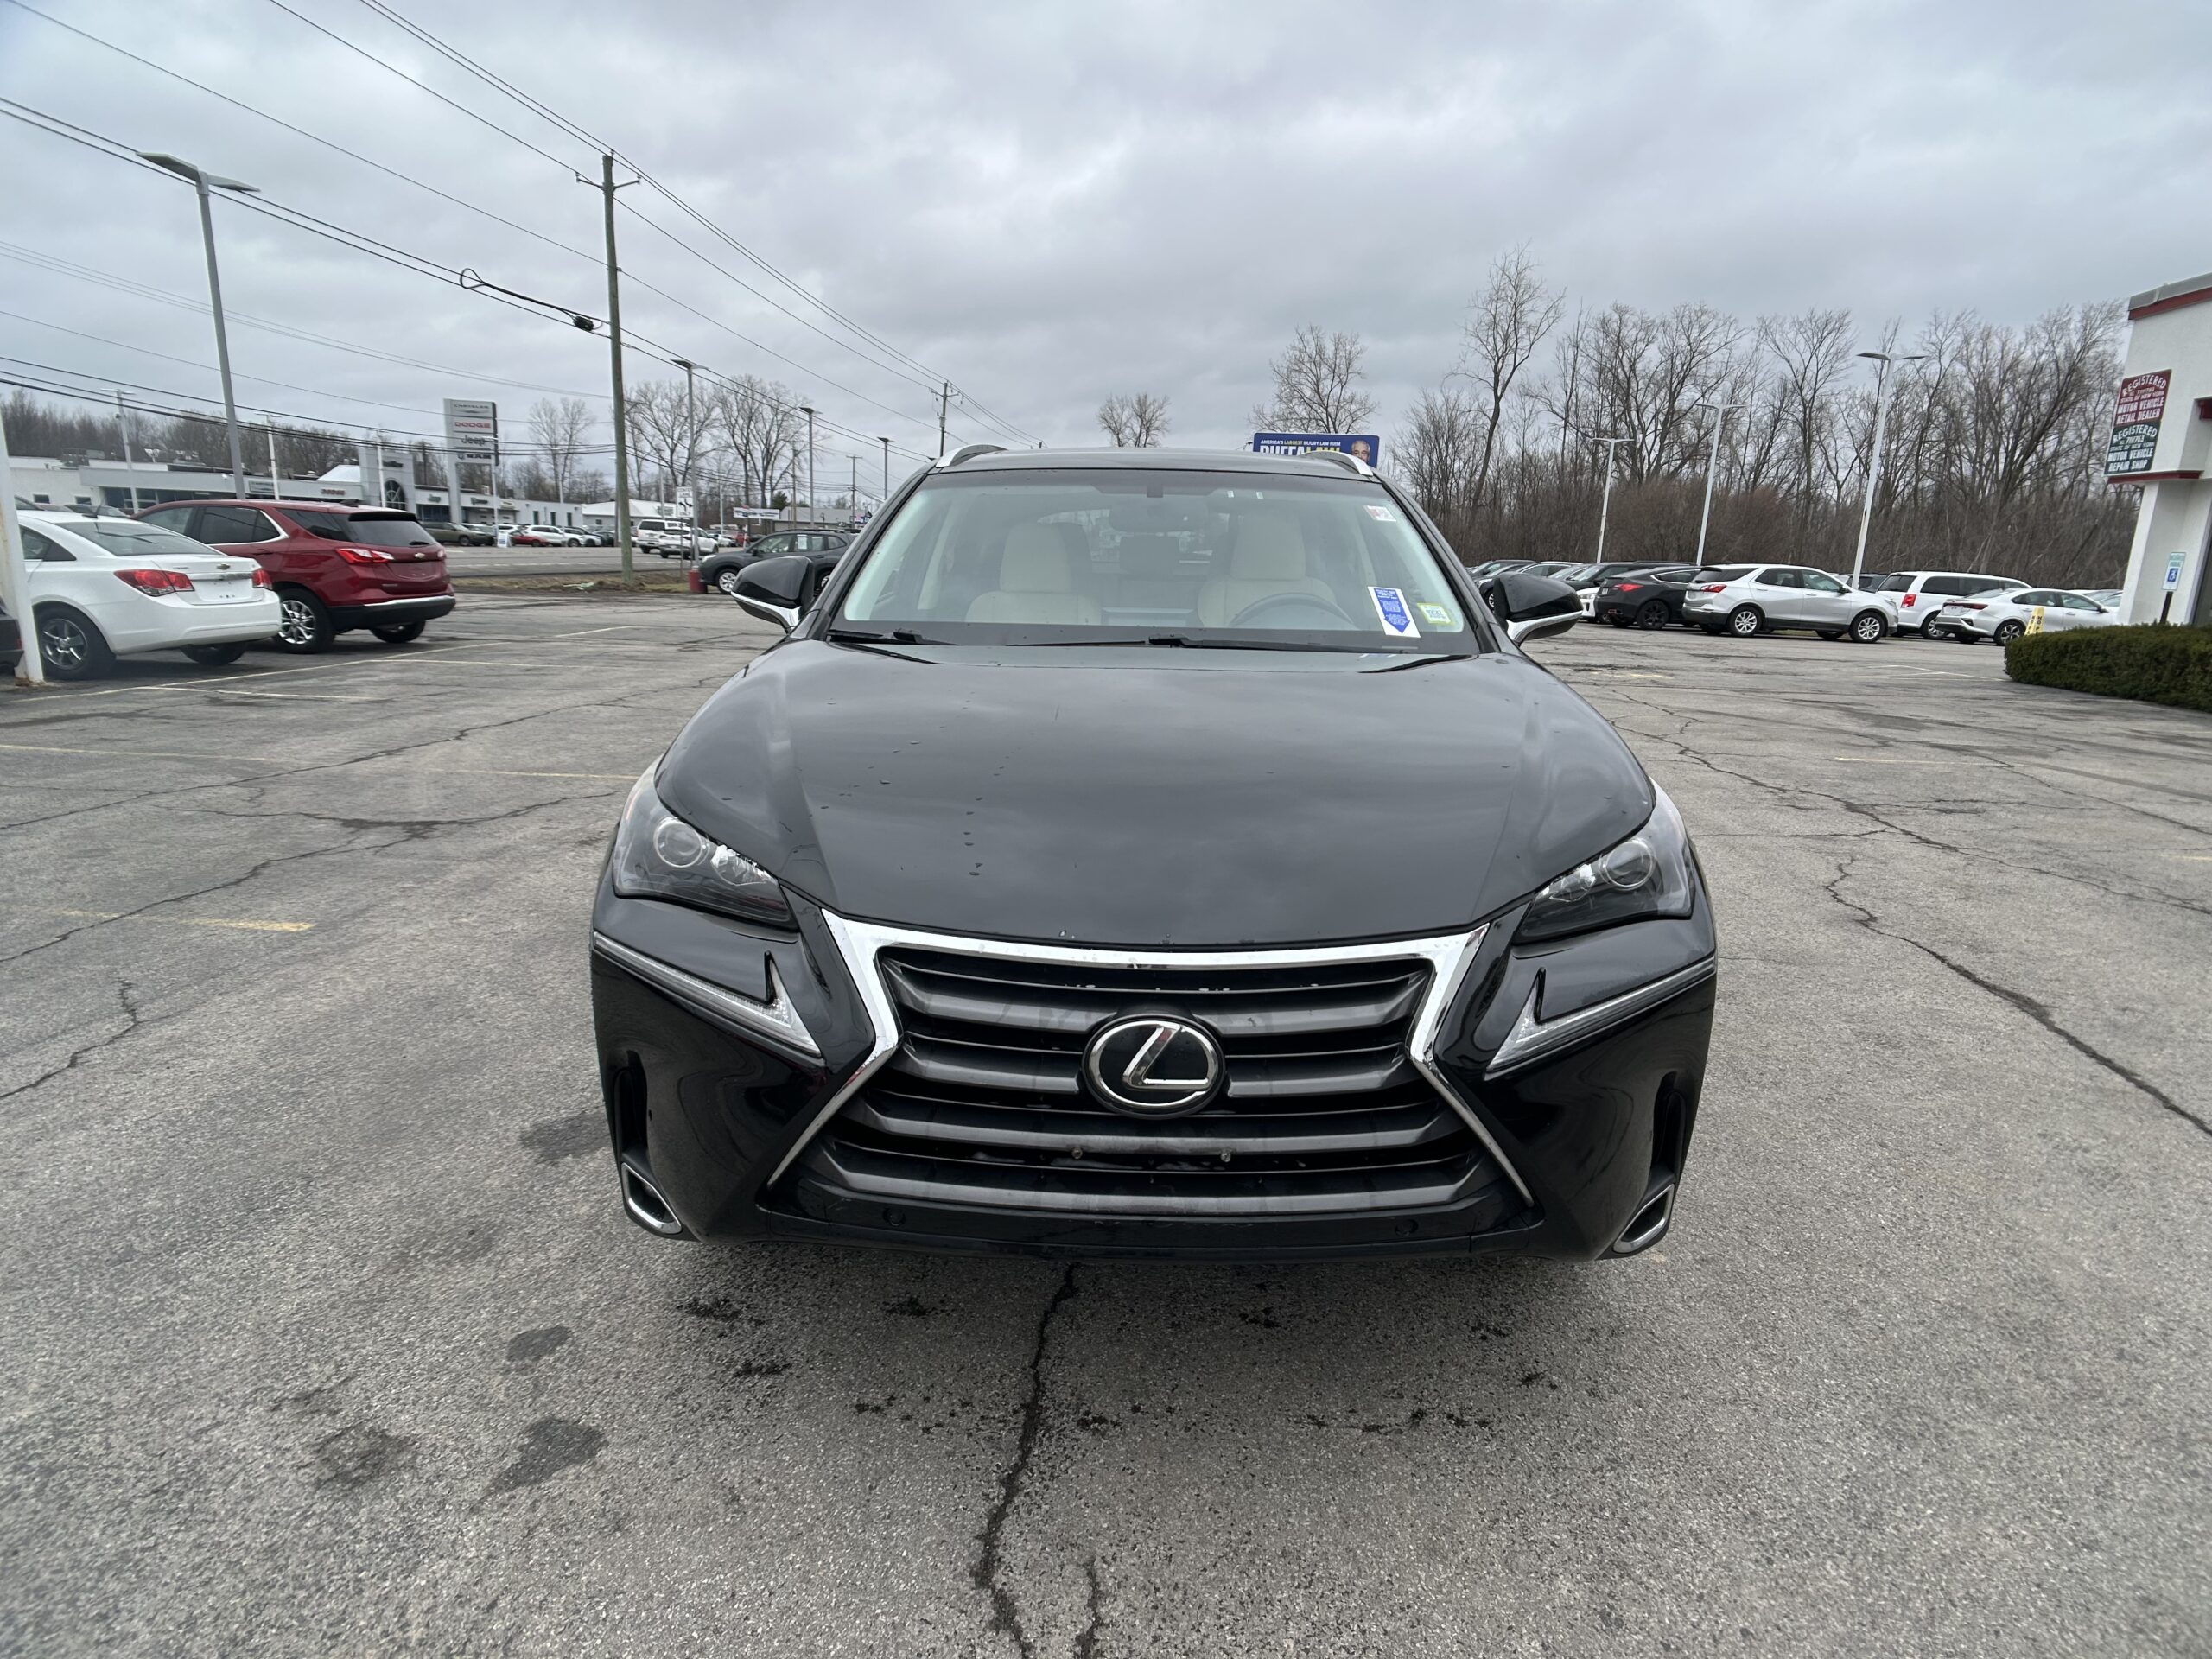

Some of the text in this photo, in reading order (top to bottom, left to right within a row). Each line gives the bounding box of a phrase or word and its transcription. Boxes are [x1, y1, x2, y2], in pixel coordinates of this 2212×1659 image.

[2122, 375, 2166, 397] REGISTERED
[2117, 397, 2165, 413] MOTOR VEHICLE
[2116, 408, 2161, 424] RETAIL DEALER
[461, 435, 486, 446] Jeep
[2113, 424, 2158, 444] REGISTERED
[2107, 448, 2153, 461] MOTOR VEHICLE
[2108, 459, 2148, 472] REPAIR SHOP
